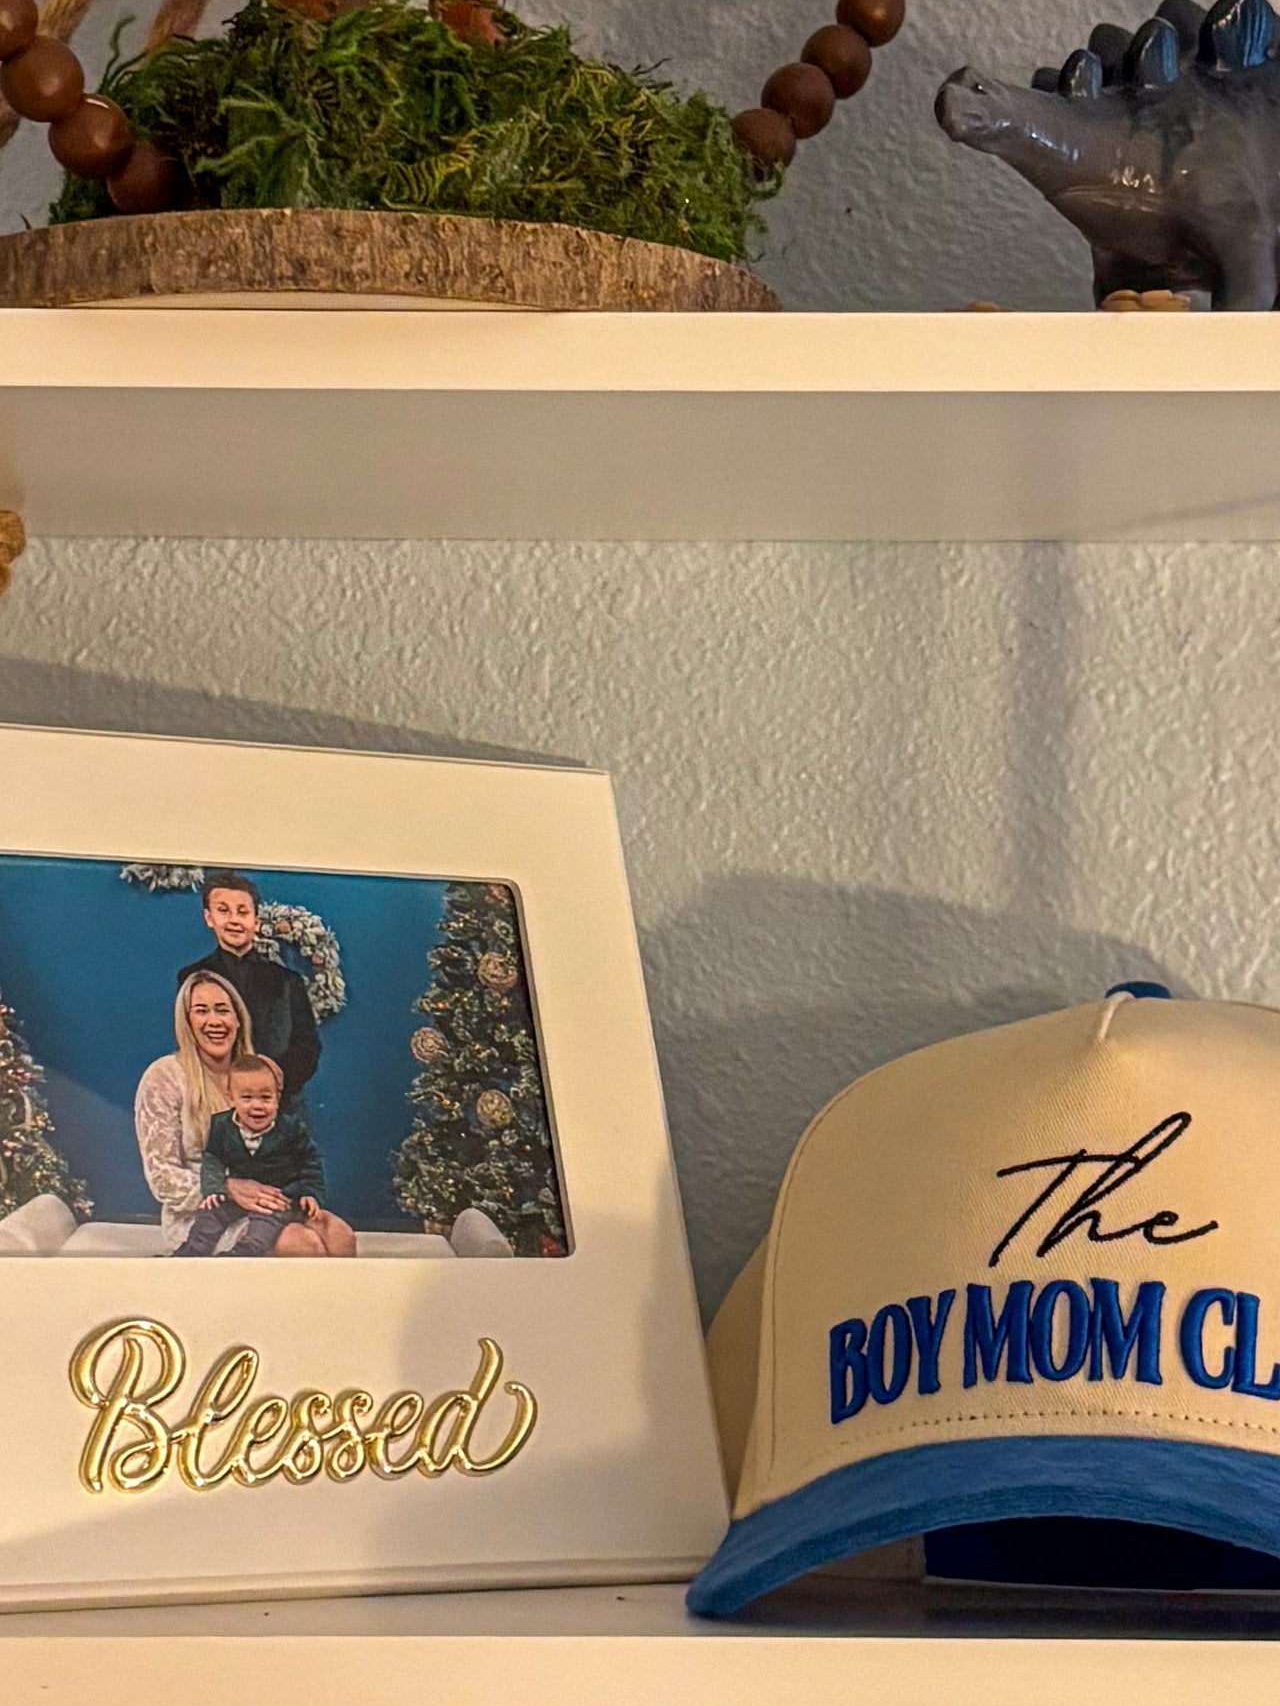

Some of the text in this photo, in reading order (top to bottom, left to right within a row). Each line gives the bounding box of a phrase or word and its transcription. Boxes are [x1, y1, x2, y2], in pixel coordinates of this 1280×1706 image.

[996, 1110, 1218, 1267] The
[69, 1315, 538, 1495] Blessed
[828, 1288, 956, 1425] BOY
[962, 1277, 1167, 1389] MOM
